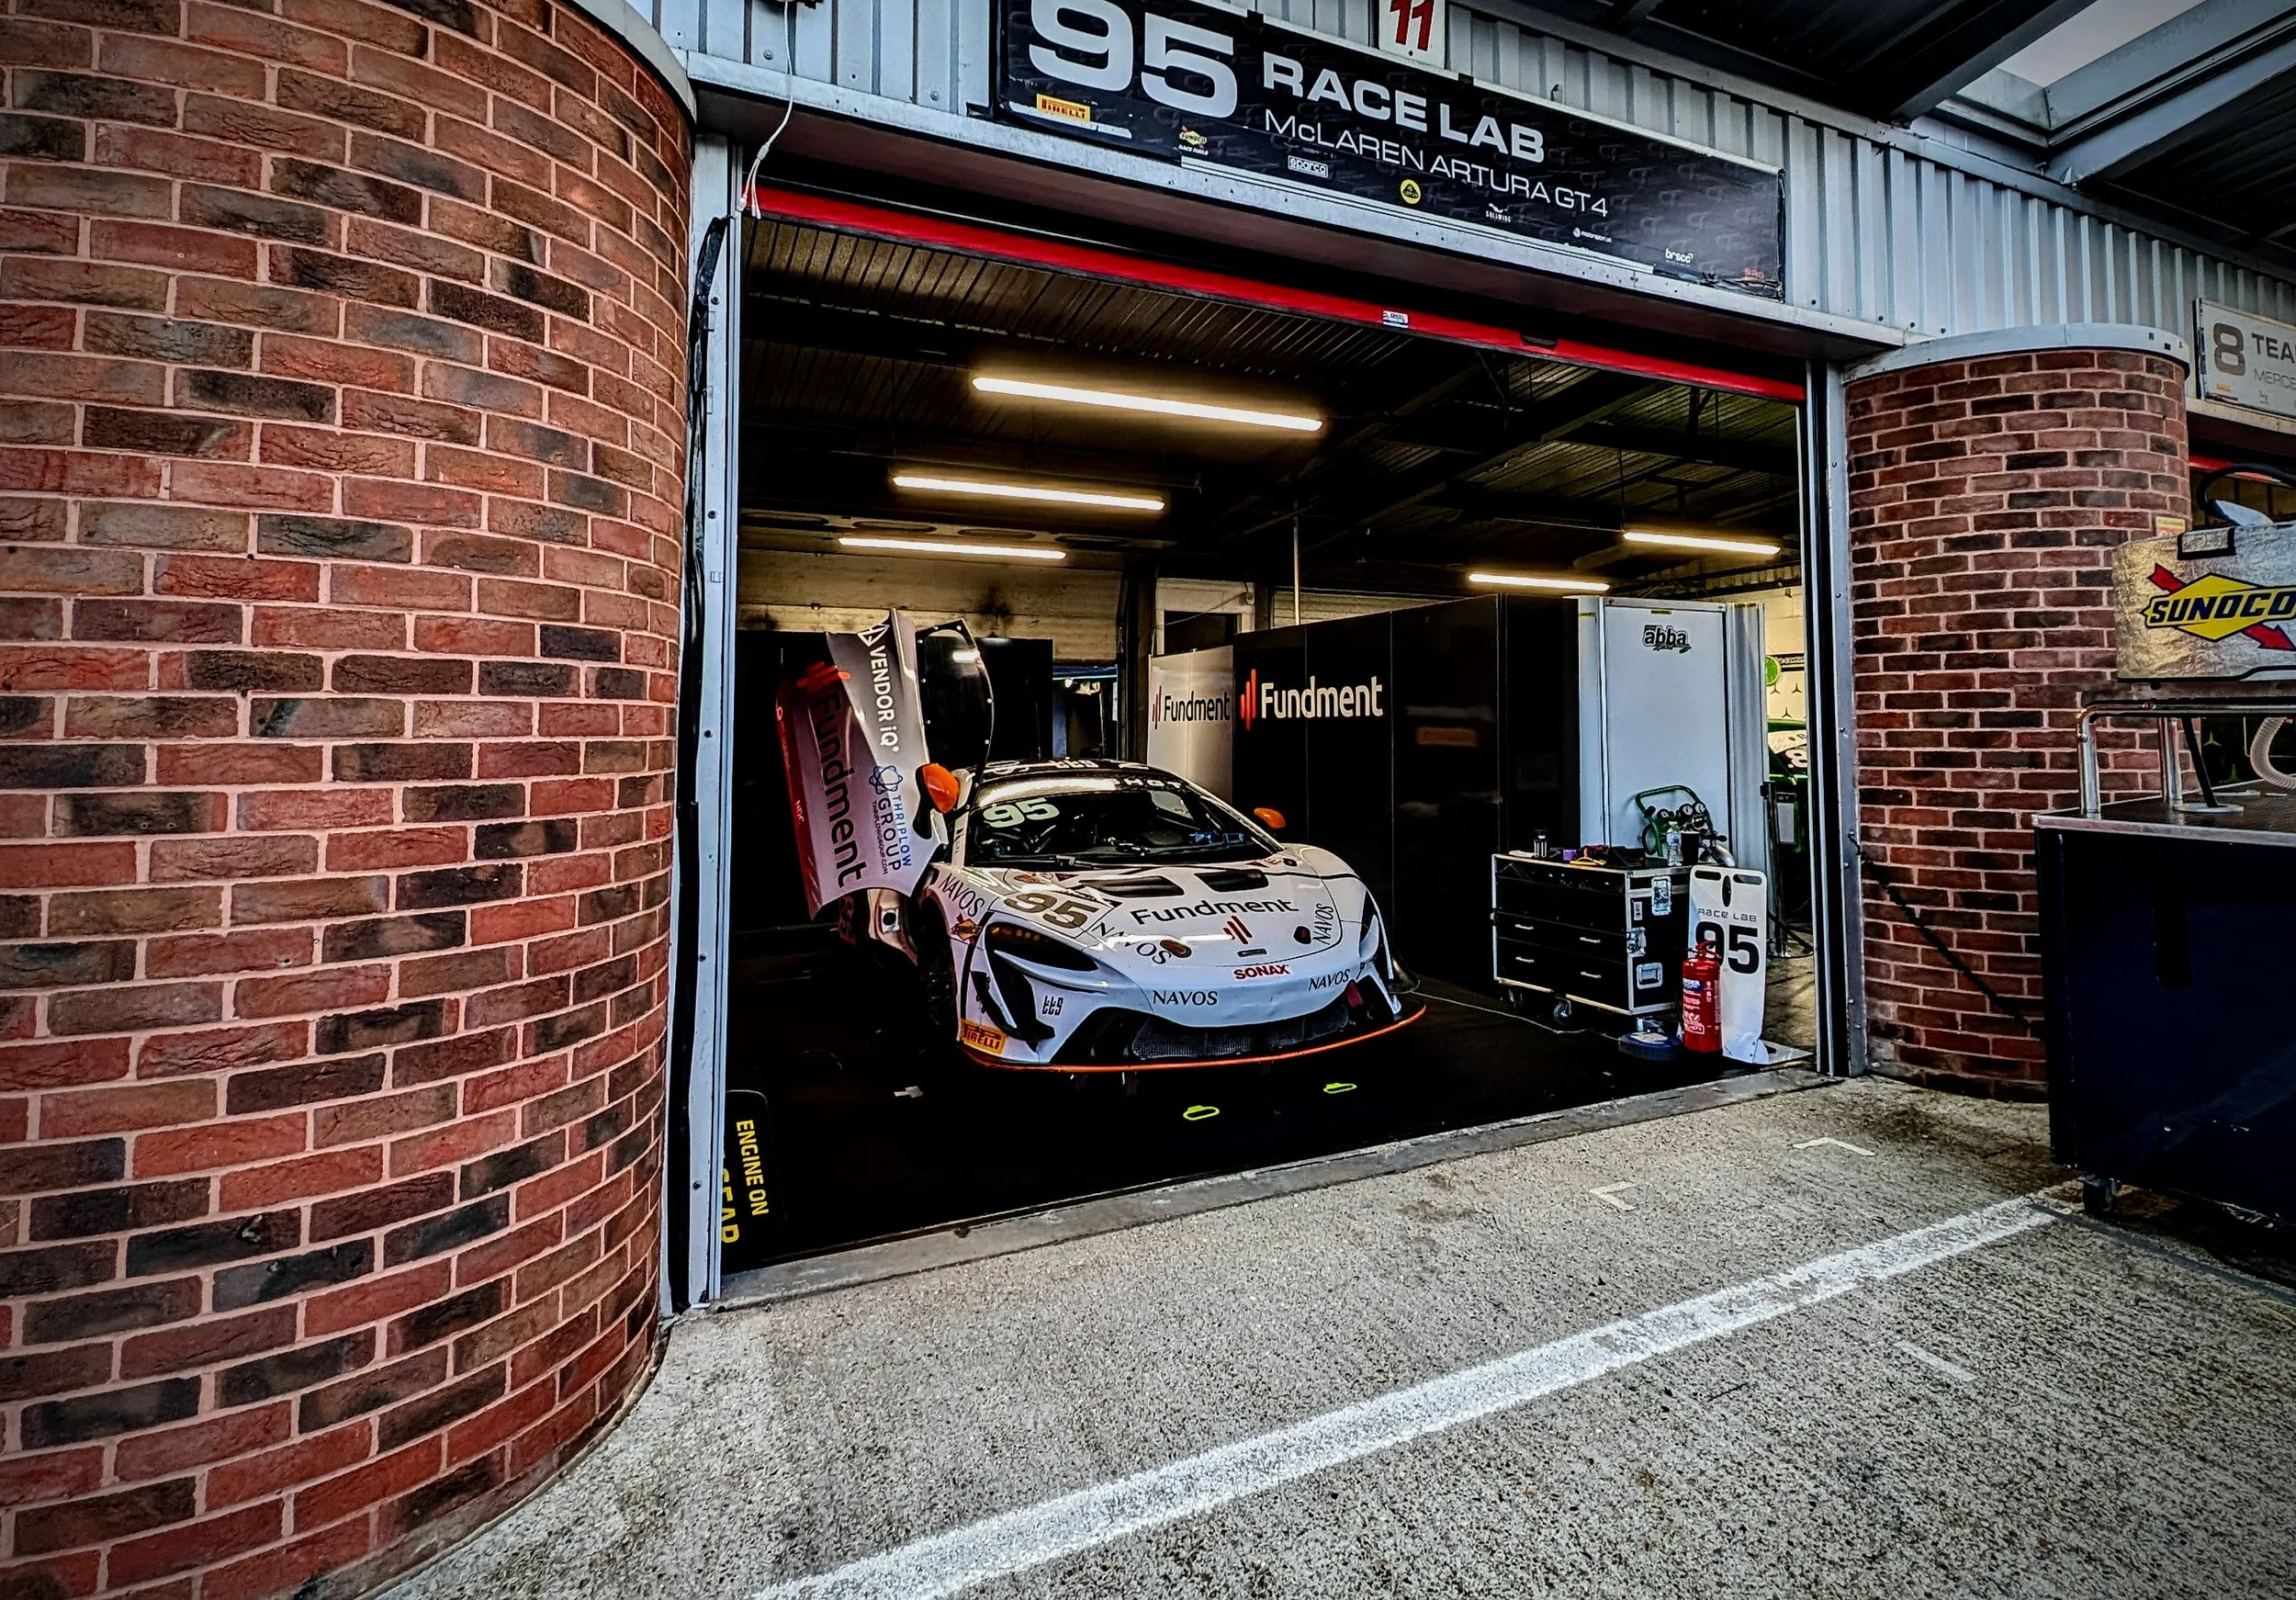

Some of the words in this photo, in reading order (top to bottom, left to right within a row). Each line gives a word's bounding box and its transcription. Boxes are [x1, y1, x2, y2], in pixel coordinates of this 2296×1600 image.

[1390, 0, 1435, 51] 11
[1029, 0, 1238, 118] 95
[1041, 98, 1086, 119] PIRELLI
[1263, 51, 1428, 132] RACE
[1439, 103, 1544, 163] LAB
[1266, 108, 1424, 171] McLAREN
[1430, 155, 1550, 203] ARTURA
[1555, 186, 1607, 217] GT4
[2213, 322, 2246, 377] 8
[2251, 332, 2296, 364] TEA
[2150, 591, 2296, 624] SUNOCO
[1644, 626, 1687, 645] abba
[869, 645, 895, 723] VENDOR
[1261, 675, 1384, 719] Fundment
[1164, 691, 1231, 723] Fundment
[811, 690, 868, 889] Fundment
[892, 794, 912, 867] THRIPLOW
[983, 797, 1060, 828] 95
[877, 797, 902, 872] GROUP
[939, 873, 985, 918] NAVOS
[1003, 892, 1100, 930] 95
[1130, 898, 1300, 925] Fundment
[1092, 921, 1172, 964] NOS
[1312, 903, 1334, 945] NAVOS
[1233, 964, 1290, 980] SONAX
[1309, 968, 1351, 992] NAVOS
[1152, 990, 1219, 1006] NAVOS
[962, 1022, 1002, 1050] PIRELLI
[736, 1120, 764, 1187] ENGINE
[748, 1189, 770, 1216] ON
